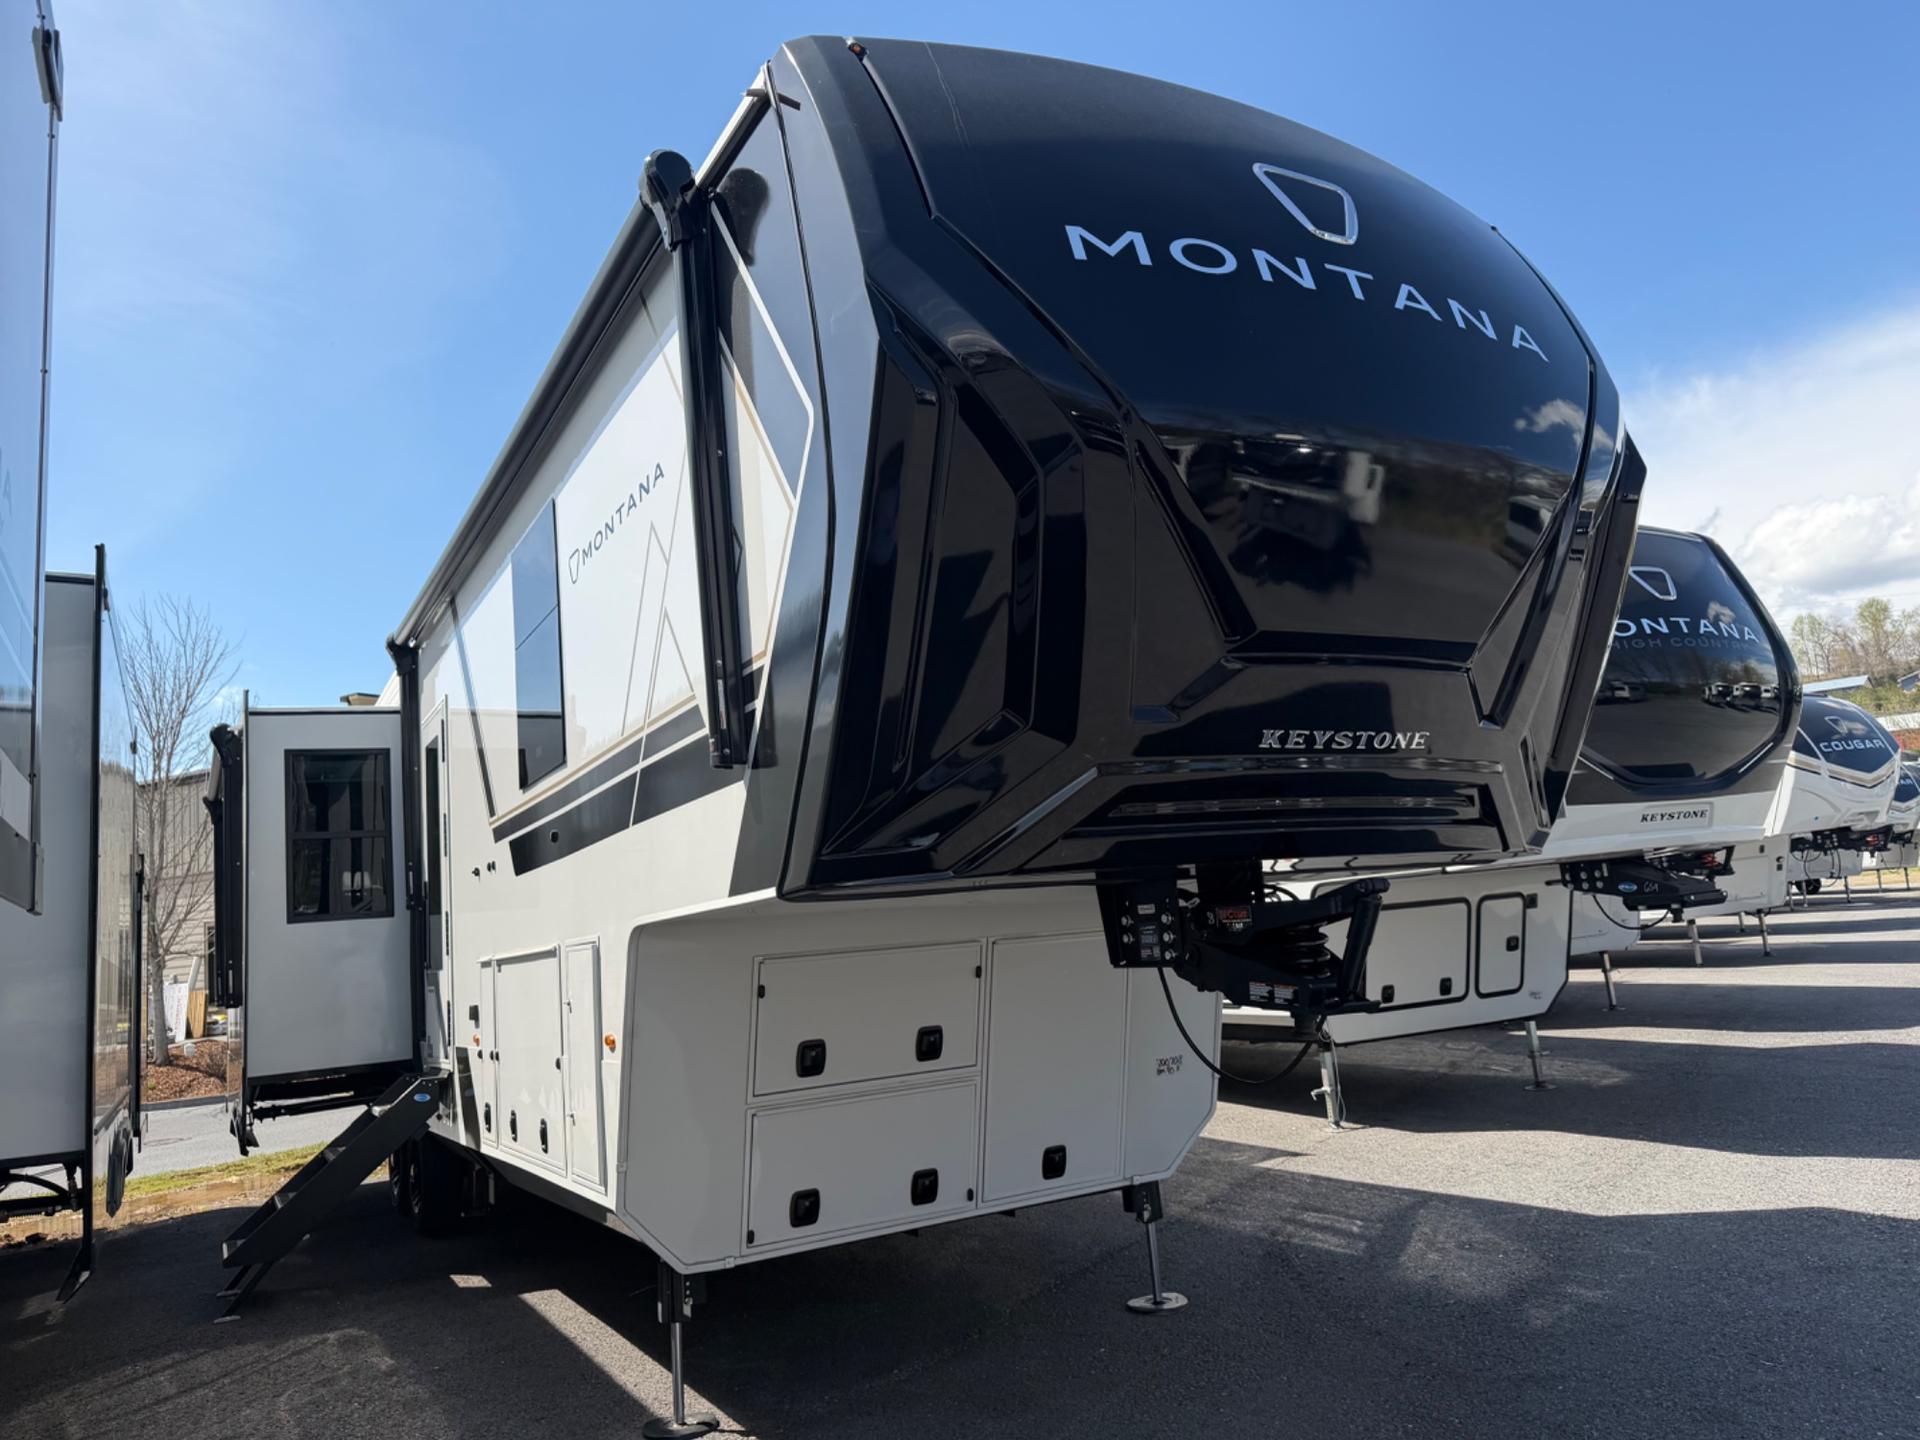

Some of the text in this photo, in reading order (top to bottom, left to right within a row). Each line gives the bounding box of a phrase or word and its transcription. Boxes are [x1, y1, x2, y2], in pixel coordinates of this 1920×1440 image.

[1065, 225, 1548, 361] MONTANA
[582, 462, 664, 566] MONTANA
[1614, 617, 1759, 643] ONTANA
[1258, 729, 1430, 750] KEYSTONE
[1820, 739, 1885, 752] COUGAR
[1640, 809, 1708, 823] KEYSTONE
